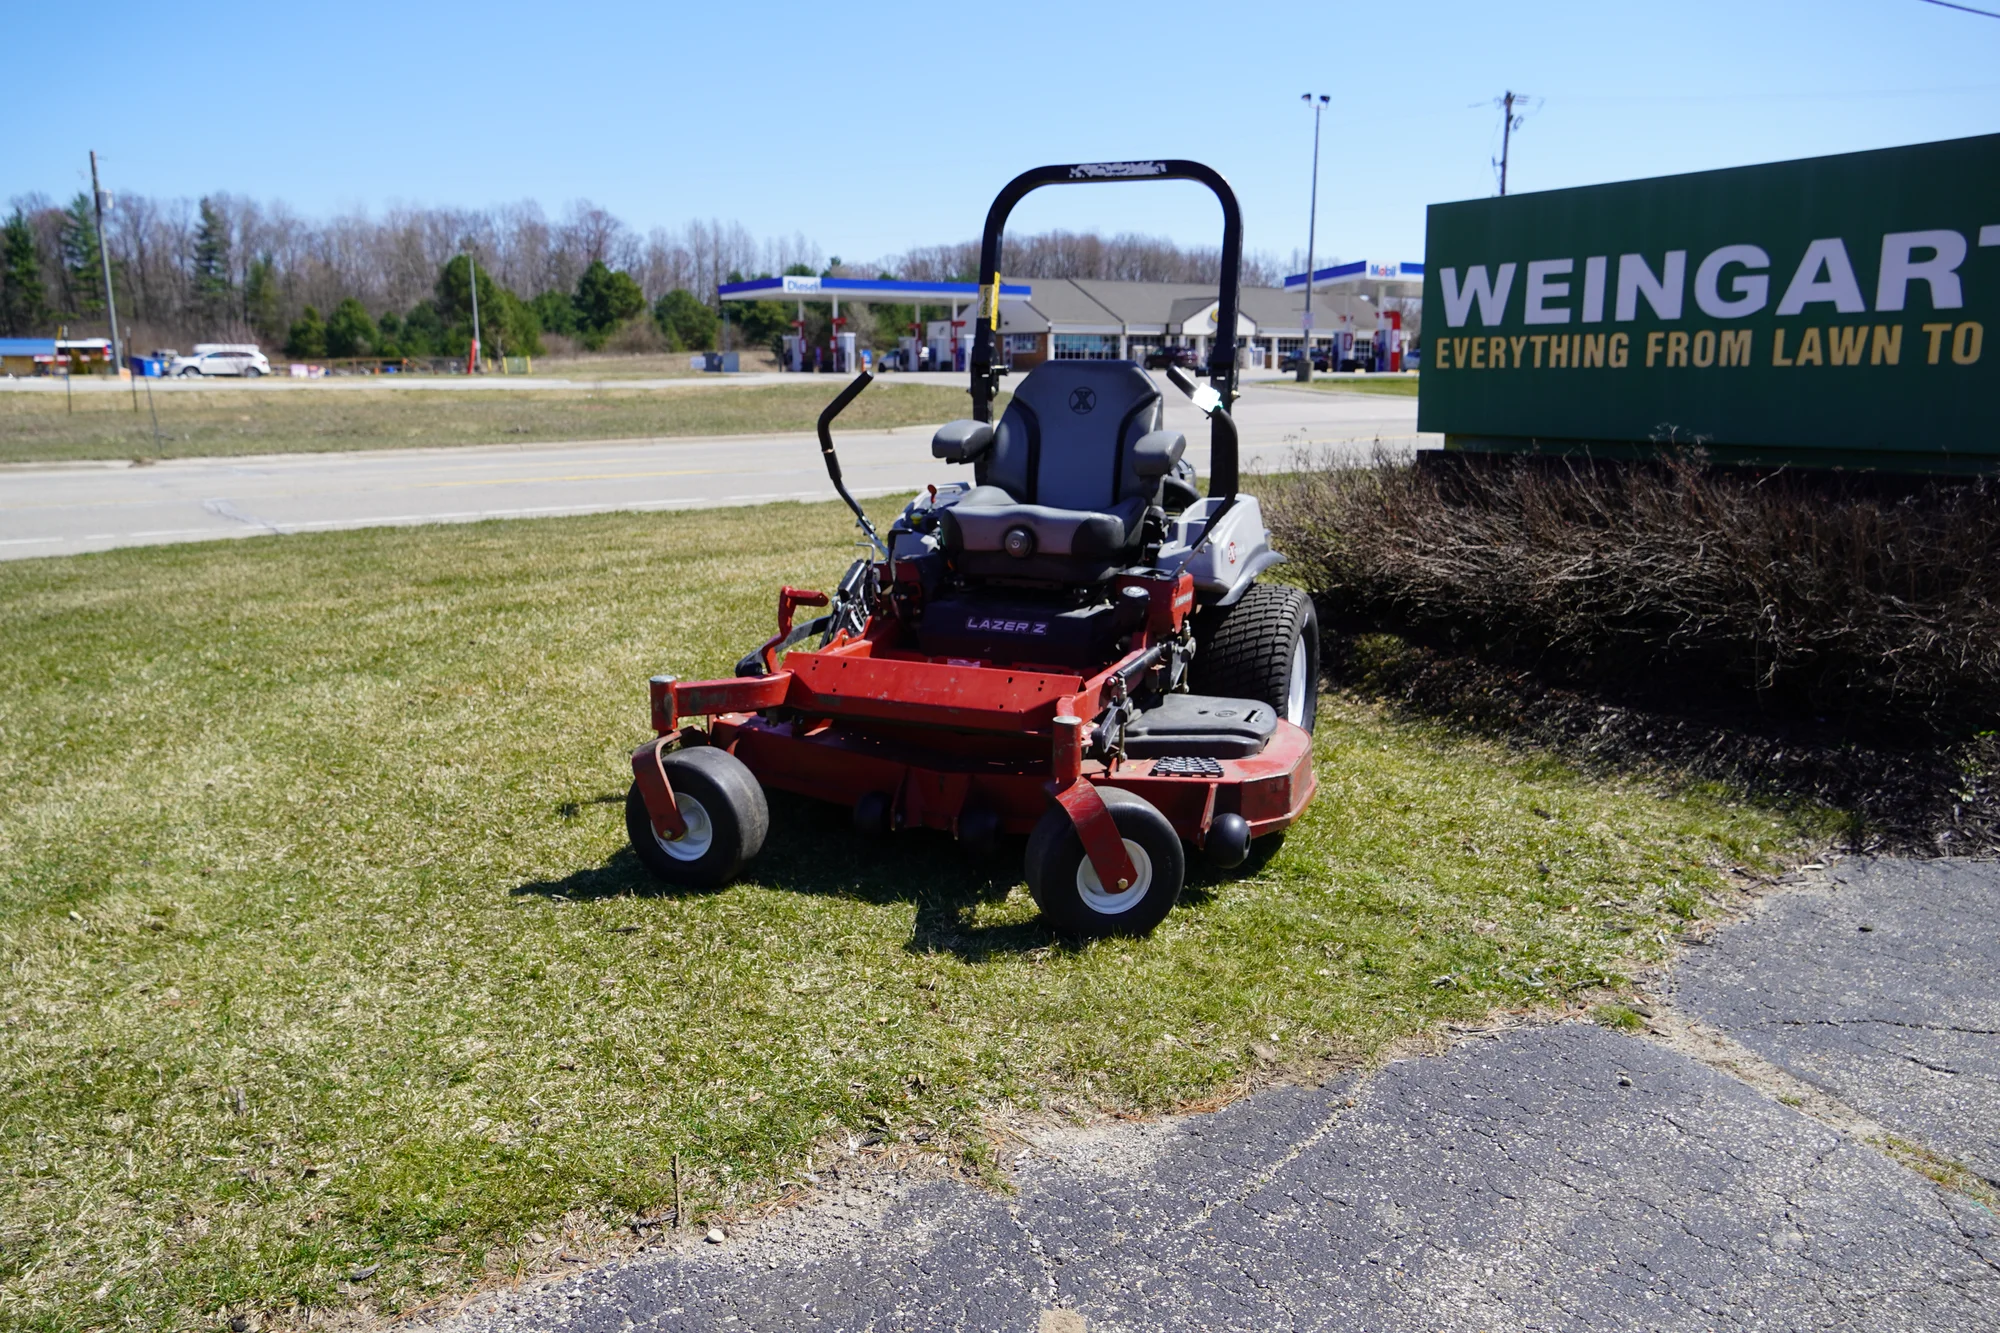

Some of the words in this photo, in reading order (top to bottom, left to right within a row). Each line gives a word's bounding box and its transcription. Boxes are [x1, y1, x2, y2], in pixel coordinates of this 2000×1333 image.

[1370, 264, 1396, 277] Mobil
[787, 279, 819, 292] Diesel
[1435, 332, 1630, 369] EVERYTHING
[1645, 328, 1753, 368] FROM
[1772, 324, 1904, 367] LAWN
[1921, 320, 1985, 366] TO
[967, 617, 1029, 632] LAZER
[1032, 622, 1047, 634] Z
